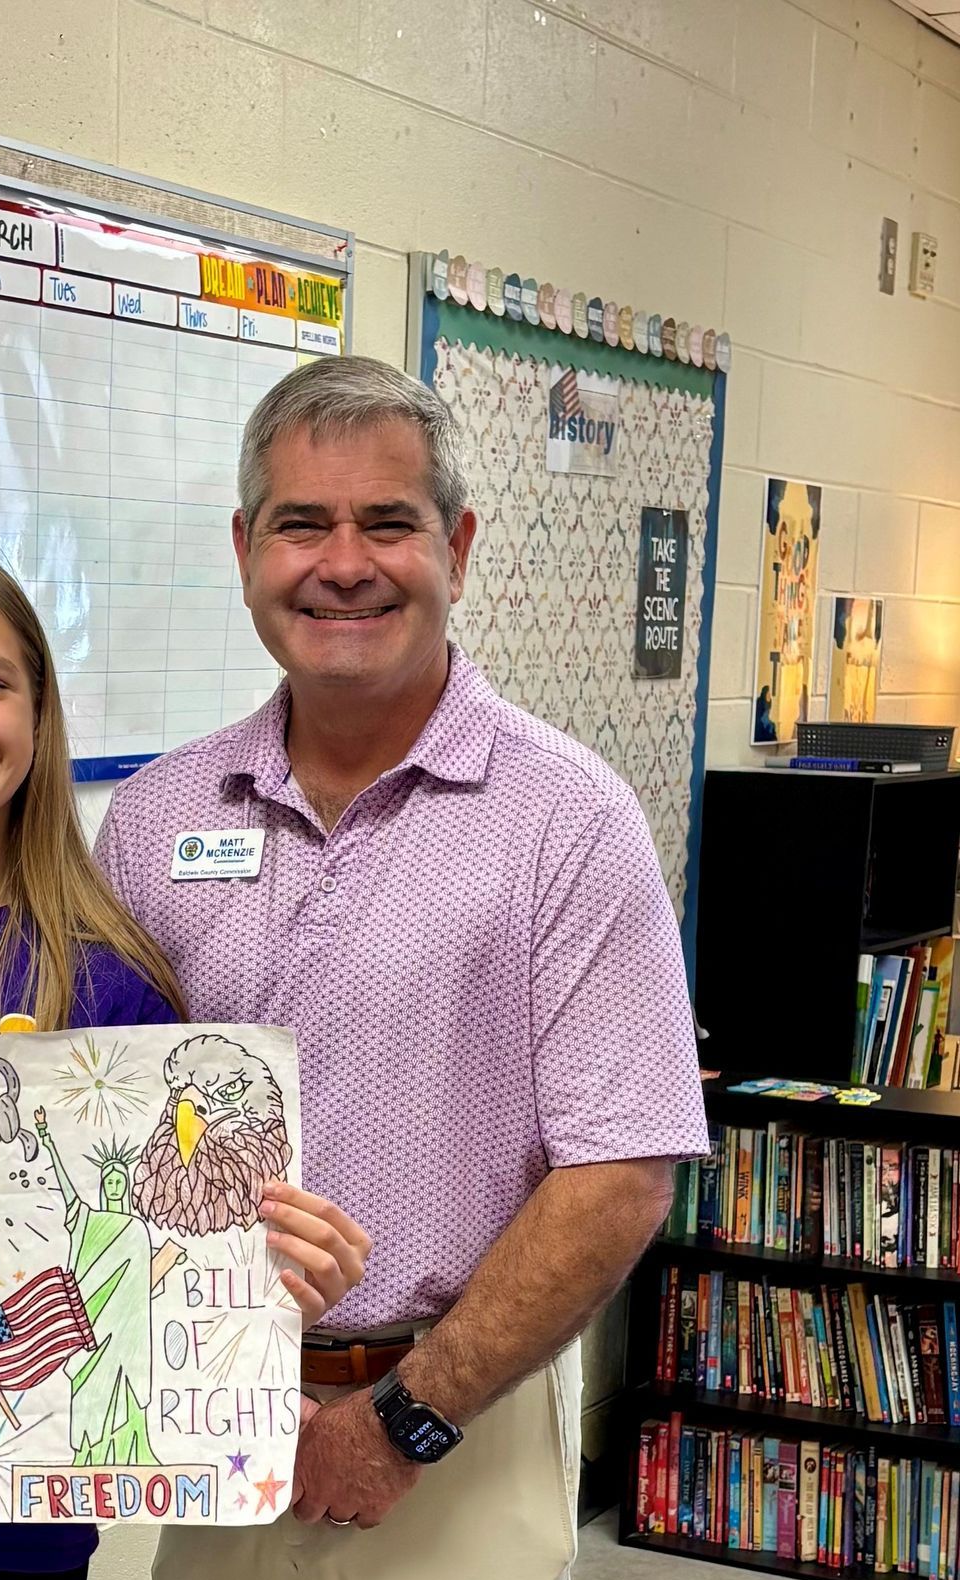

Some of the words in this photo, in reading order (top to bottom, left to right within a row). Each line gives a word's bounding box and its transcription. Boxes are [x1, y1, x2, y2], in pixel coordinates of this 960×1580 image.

[49, 277, 76, 302] Tues
[201, 256, 245, 299] DREAM
[255, 267, 287, 309] PLAN
[297, 278, 340, 320] ACHIEVE
[549, 411, 616, 455] history
[651, 537, 676, 563] TAKE
[654, 567, 670, 593] THE
[643, 596, 679, 622] SCENIC
[645, 625, 679, 651] ROUTE
[206, 847, 255, 858] MCKENZIE
[219, 838, 245, 847] MATT
[738, 1170, 750, 1200] WINK
[184, 1268, 266, 1309] BILL
[164, 1320, 214, 1371] OF
[159, 1387, 300, 1437] RIGHTS
[20, 1473, 212, 1519] FREEDOM
